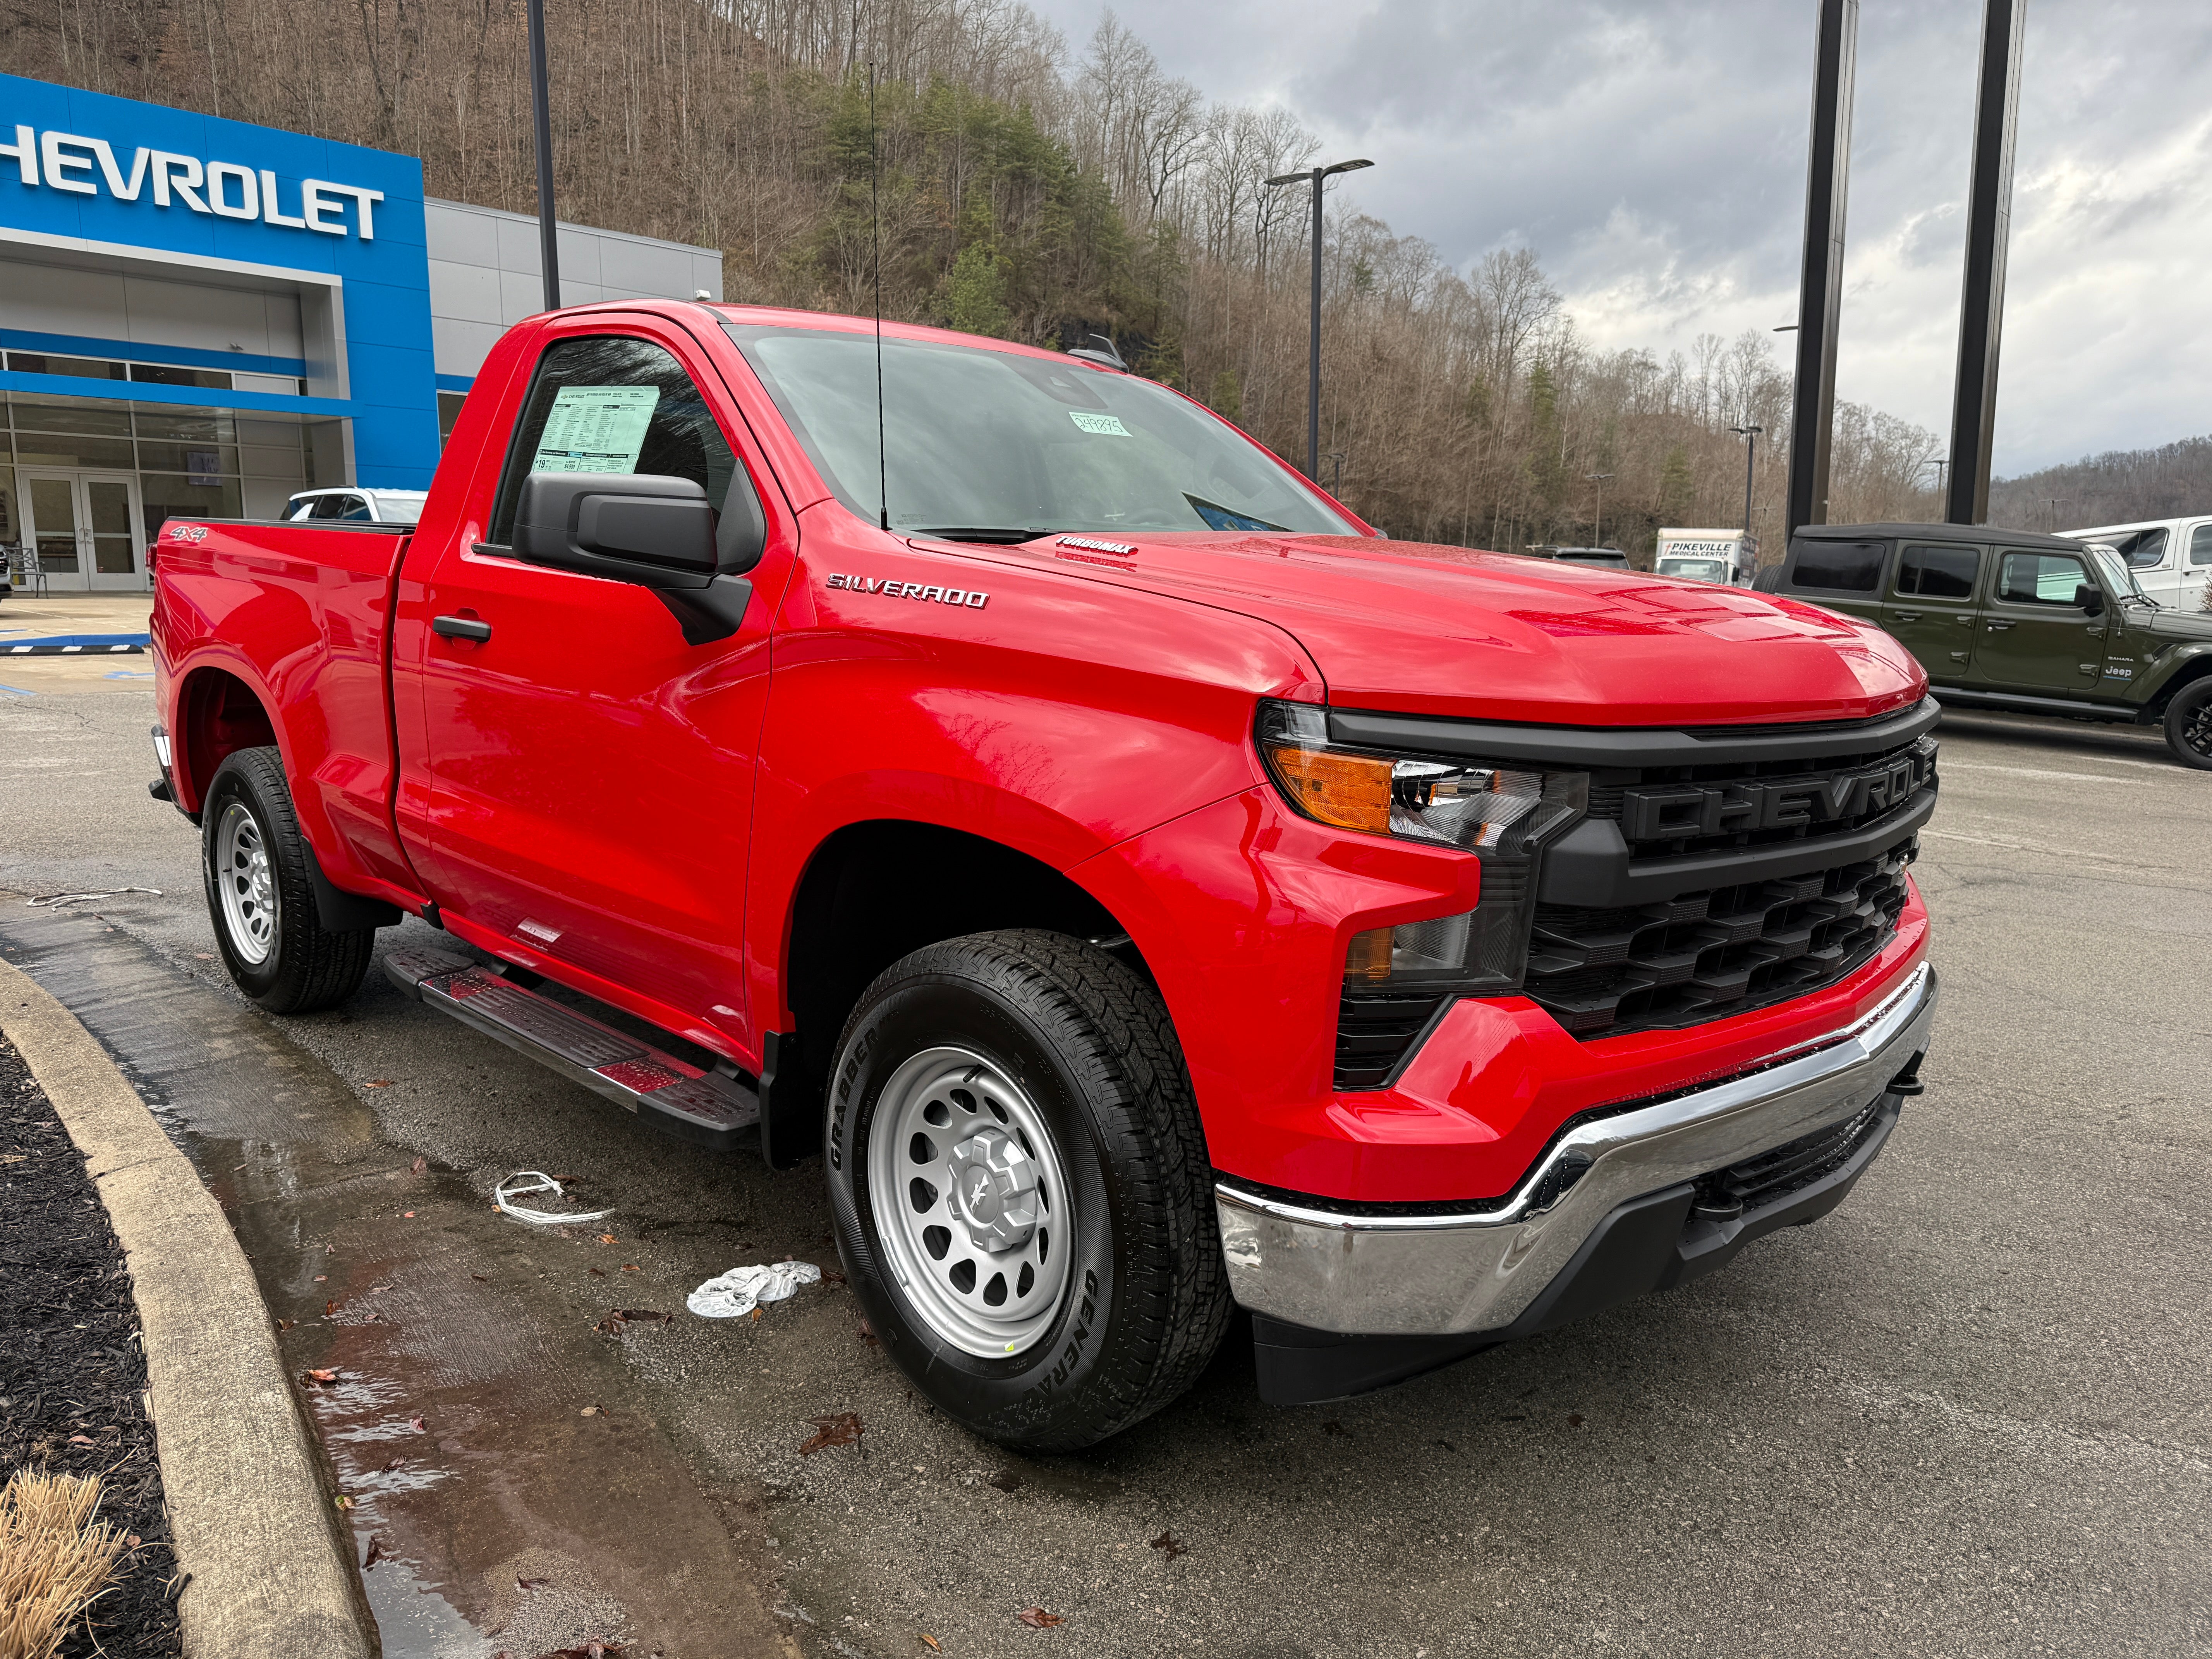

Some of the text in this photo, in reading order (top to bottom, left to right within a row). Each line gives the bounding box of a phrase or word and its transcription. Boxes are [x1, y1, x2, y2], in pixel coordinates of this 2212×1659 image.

[1075, 417, 1123, 432] 249895
[538, 459, 546, 468] 19
[1056, 536, 1139, 556] TURBOMAX
[825, 573, 991, 610] SILVERADO
[2105, 666, 2131, 677] Jeep
[831, 1027, 879, 1171] GRABBER
[1022, 1269, 1098, 1404] GENERAL
